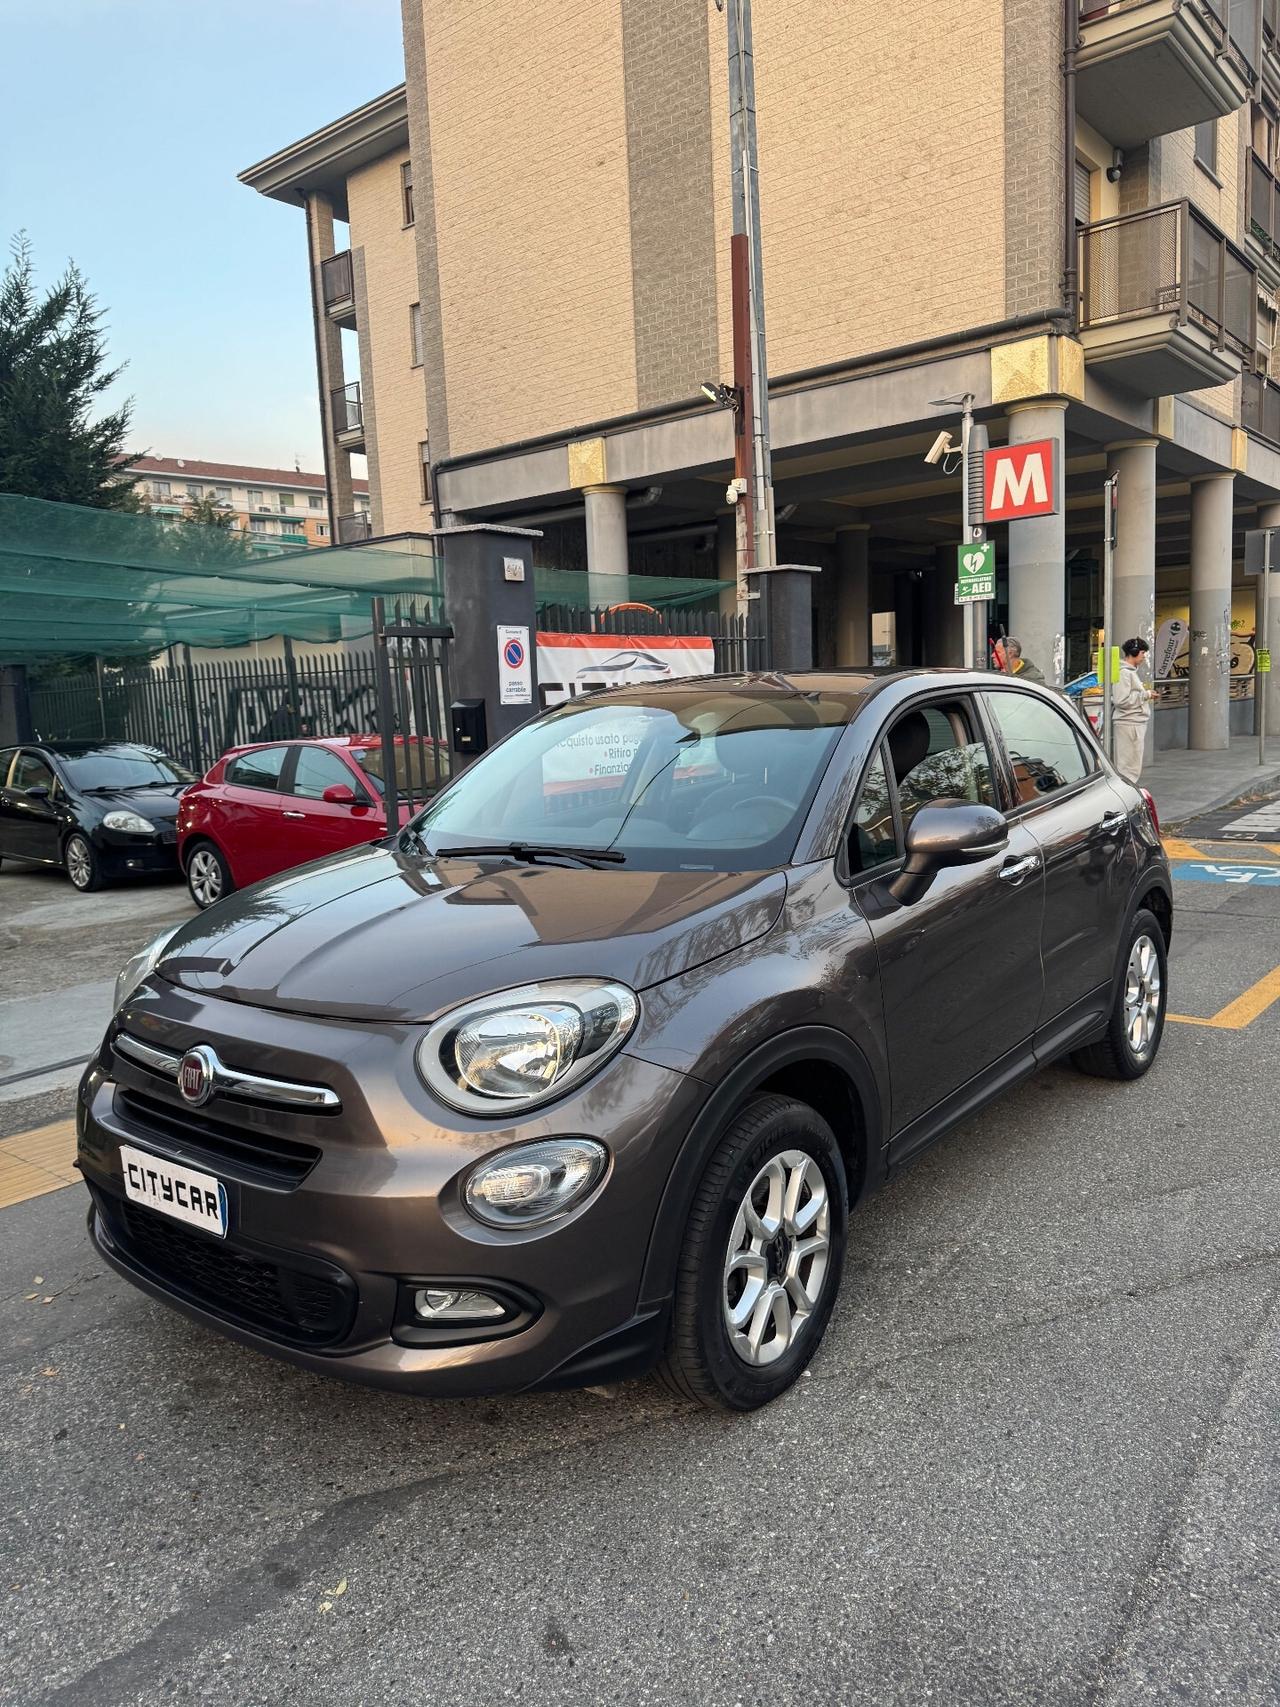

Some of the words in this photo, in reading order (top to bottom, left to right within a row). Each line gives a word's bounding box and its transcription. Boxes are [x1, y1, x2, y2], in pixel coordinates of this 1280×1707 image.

[990, 452, 1048, 511] M
[972, 582, 992, 593] AED
[1159, 638, 1175, 674] Carrefour
[595, 732, 620, 745] usato
[608, 748, 631, 760] Ritiro
[184, 1067, 201, 1089] FIAT
[127, 1162, 219, 1219] CITYCAR
